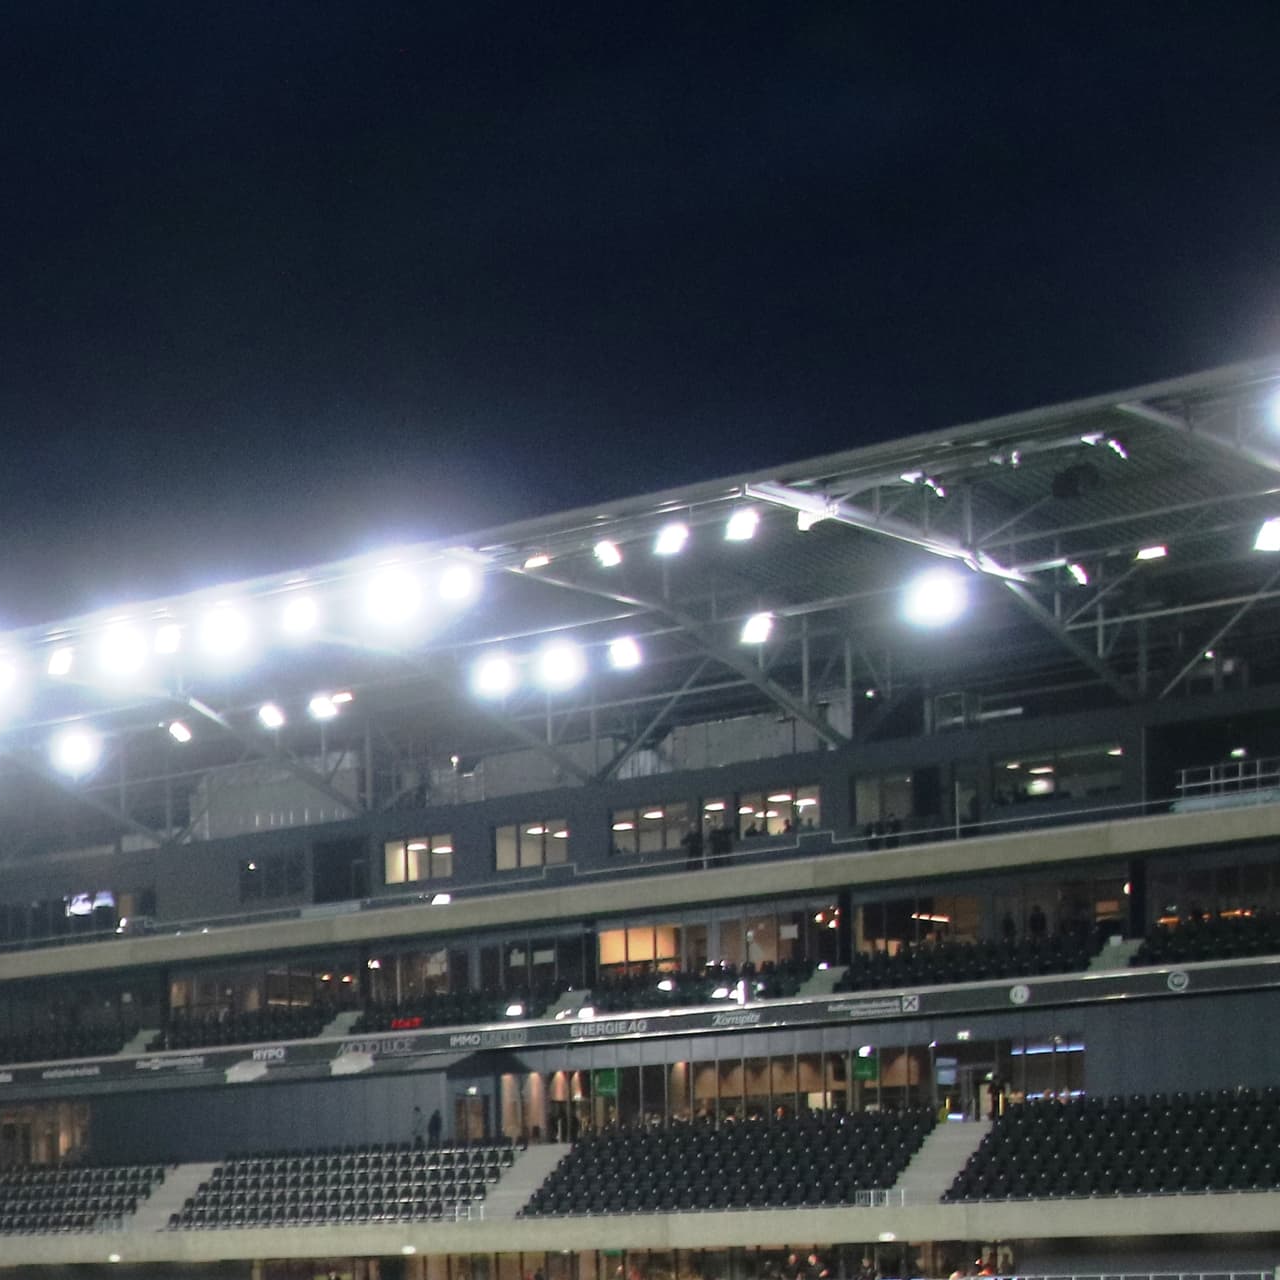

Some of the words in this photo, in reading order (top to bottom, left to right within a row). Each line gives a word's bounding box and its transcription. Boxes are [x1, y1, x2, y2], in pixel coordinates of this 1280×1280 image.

[570, 1020, 626, 1037] ENERGIE
[628, 1019, 647, 1032] AG
[450, 1036, 481, 1047] IMMO
[252, 1048, 285, 1061] HYPO
